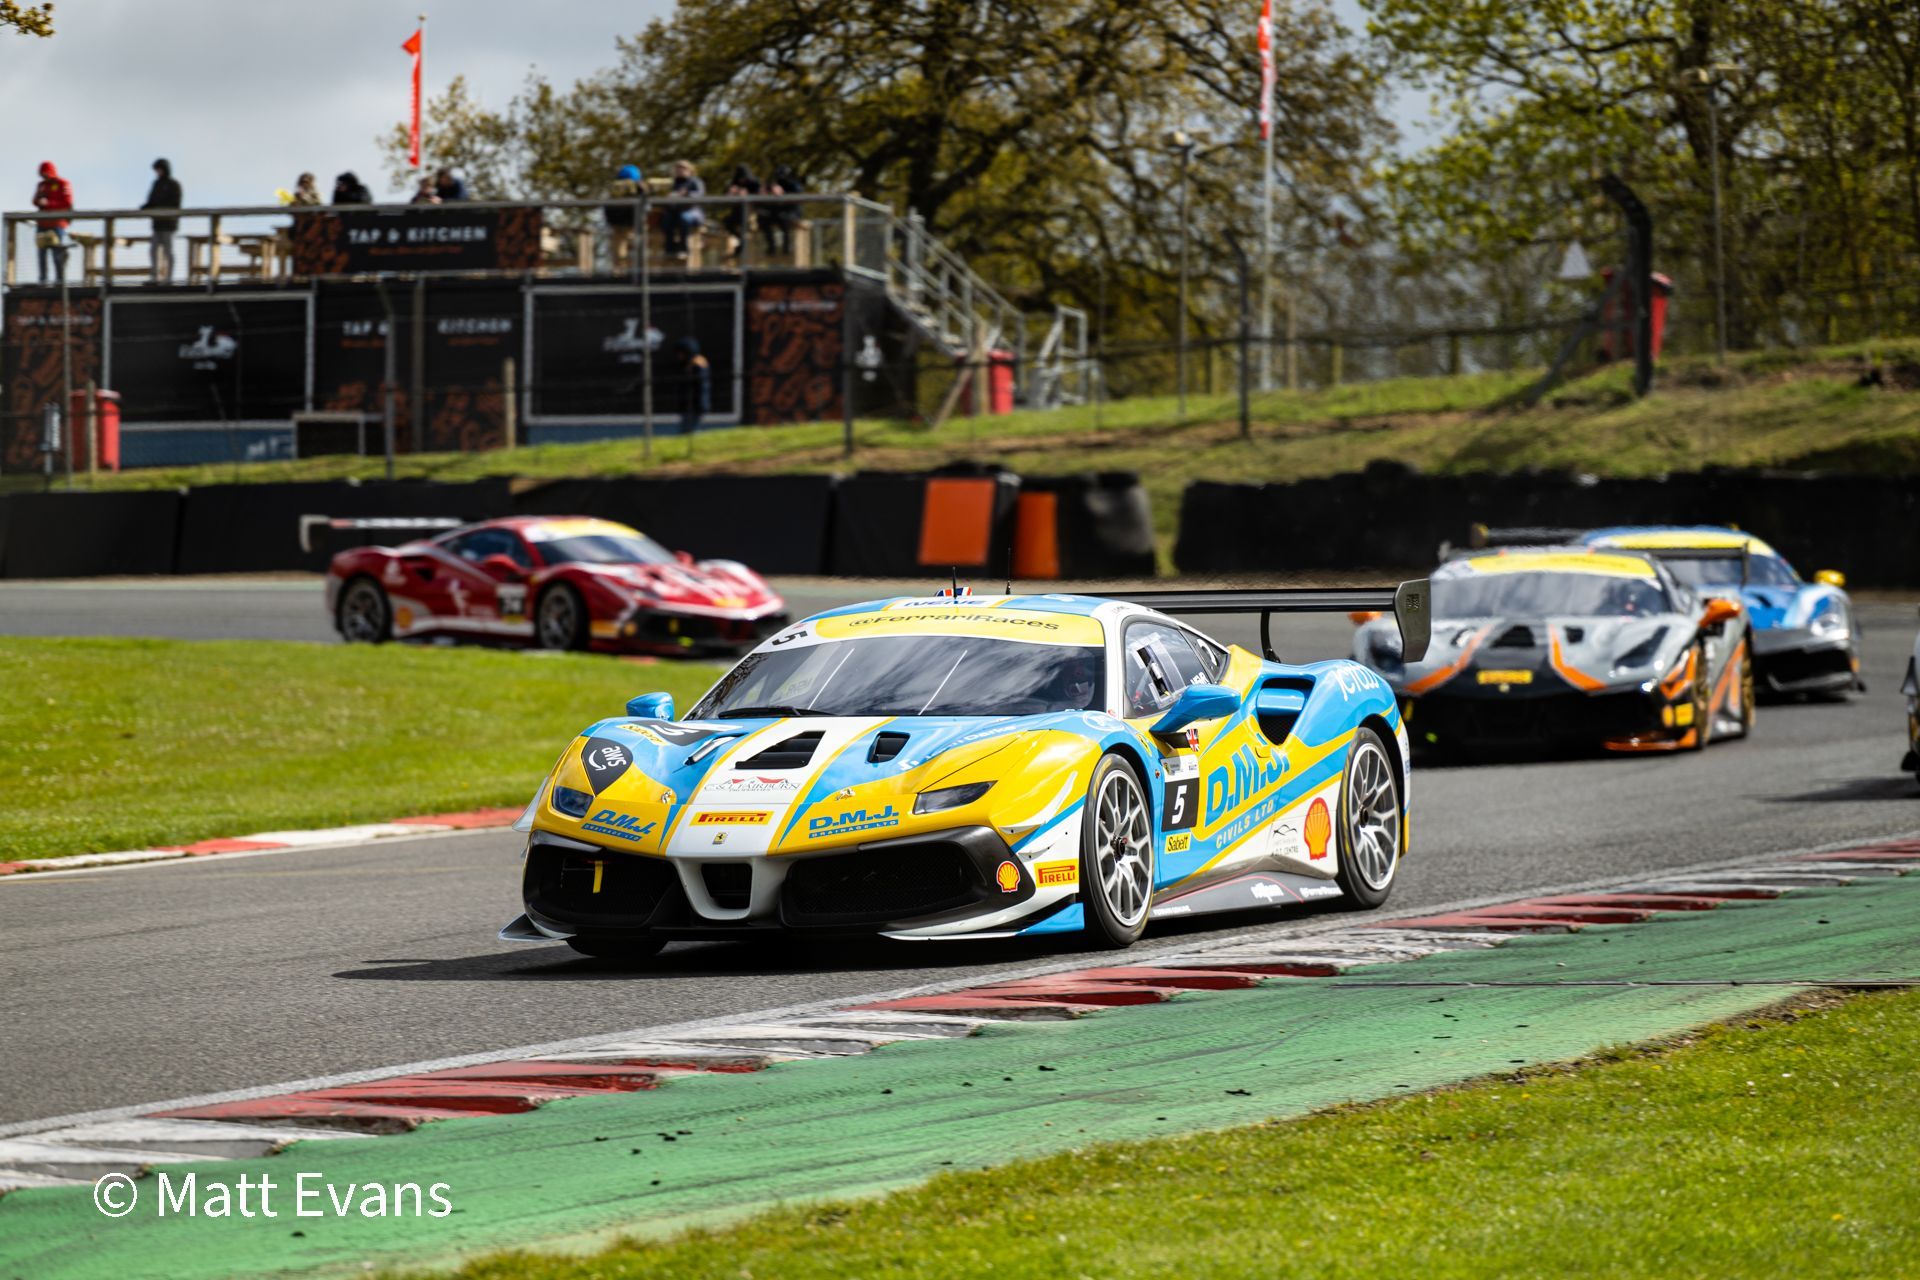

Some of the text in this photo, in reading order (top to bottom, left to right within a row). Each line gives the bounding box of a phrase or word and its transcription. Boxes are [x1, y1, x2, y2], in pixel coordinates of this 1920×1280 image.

[348, 228, 381, 243] TAP
[407, 227, 487, 242] KITCHEN
[772, 630, 808, 646] 5
[601, 745, 627, 767] aws
[1171, 784, 1187, 825] 5
[698, 813, 767, 823] PIRELLI
[809, 804, 899, 831] D.M.J.
[1216, 799, 1274, 849] CIVILS LTD
[1167, 836, 1188, 852] Sabelt
[1038, 864, 1076, 885] PIRELLI
